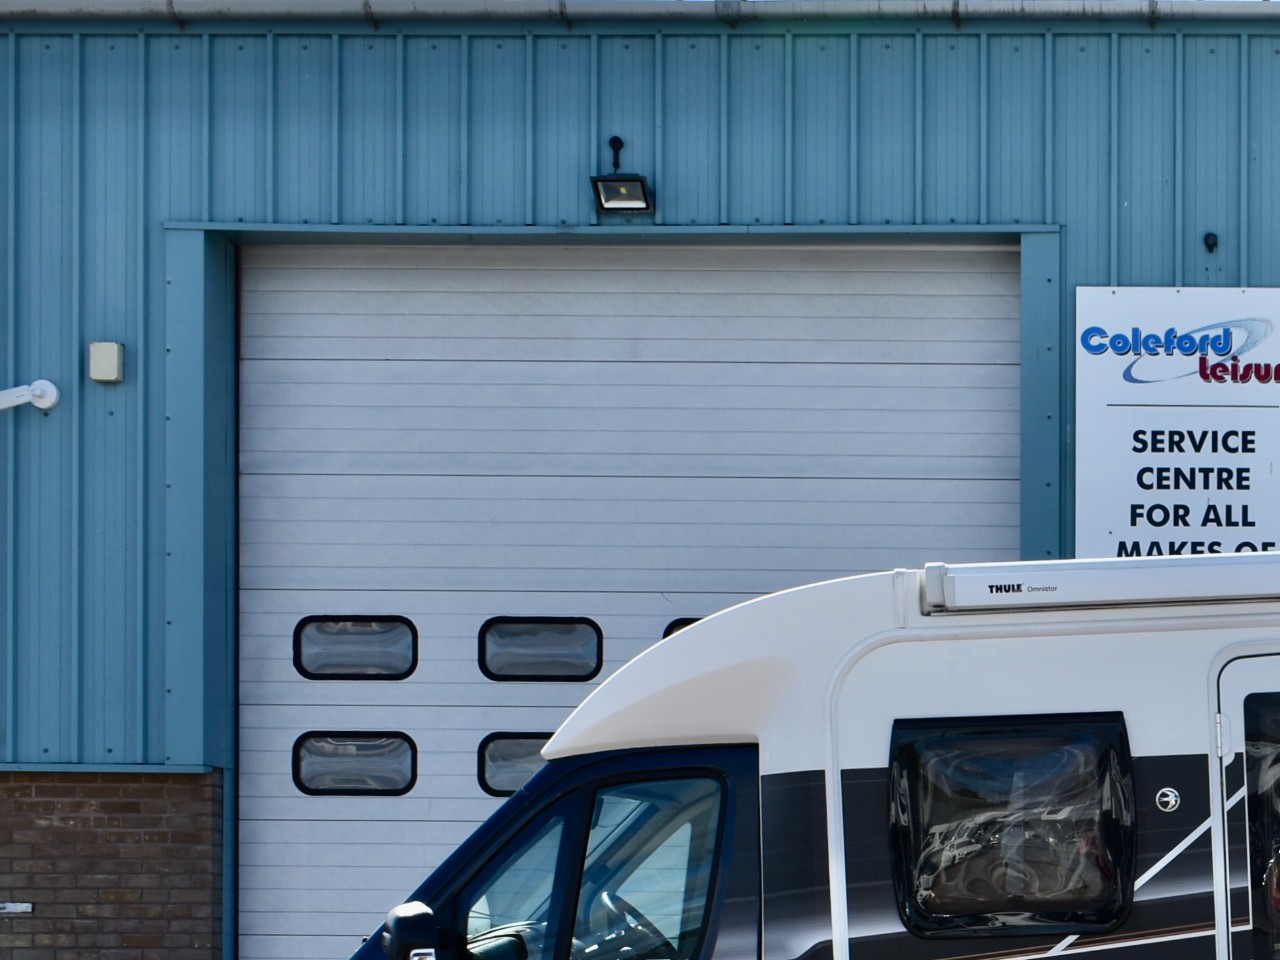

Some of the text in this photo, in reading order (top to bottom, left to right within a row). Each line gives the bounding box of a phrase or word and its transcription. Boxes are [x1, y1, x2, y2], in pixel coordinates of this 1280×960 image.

[1081, 326, 1233, 356] Coleford
[1131, 430, 1256, 453] SERVICE
[1136, 467, 1251, 490] CENTRE
[1130, 504, 1256, 527] FOR ALL
[1117, 541, 1222, 557] MAKES
[988, 583, 1058, 594] THULE Omnistor
